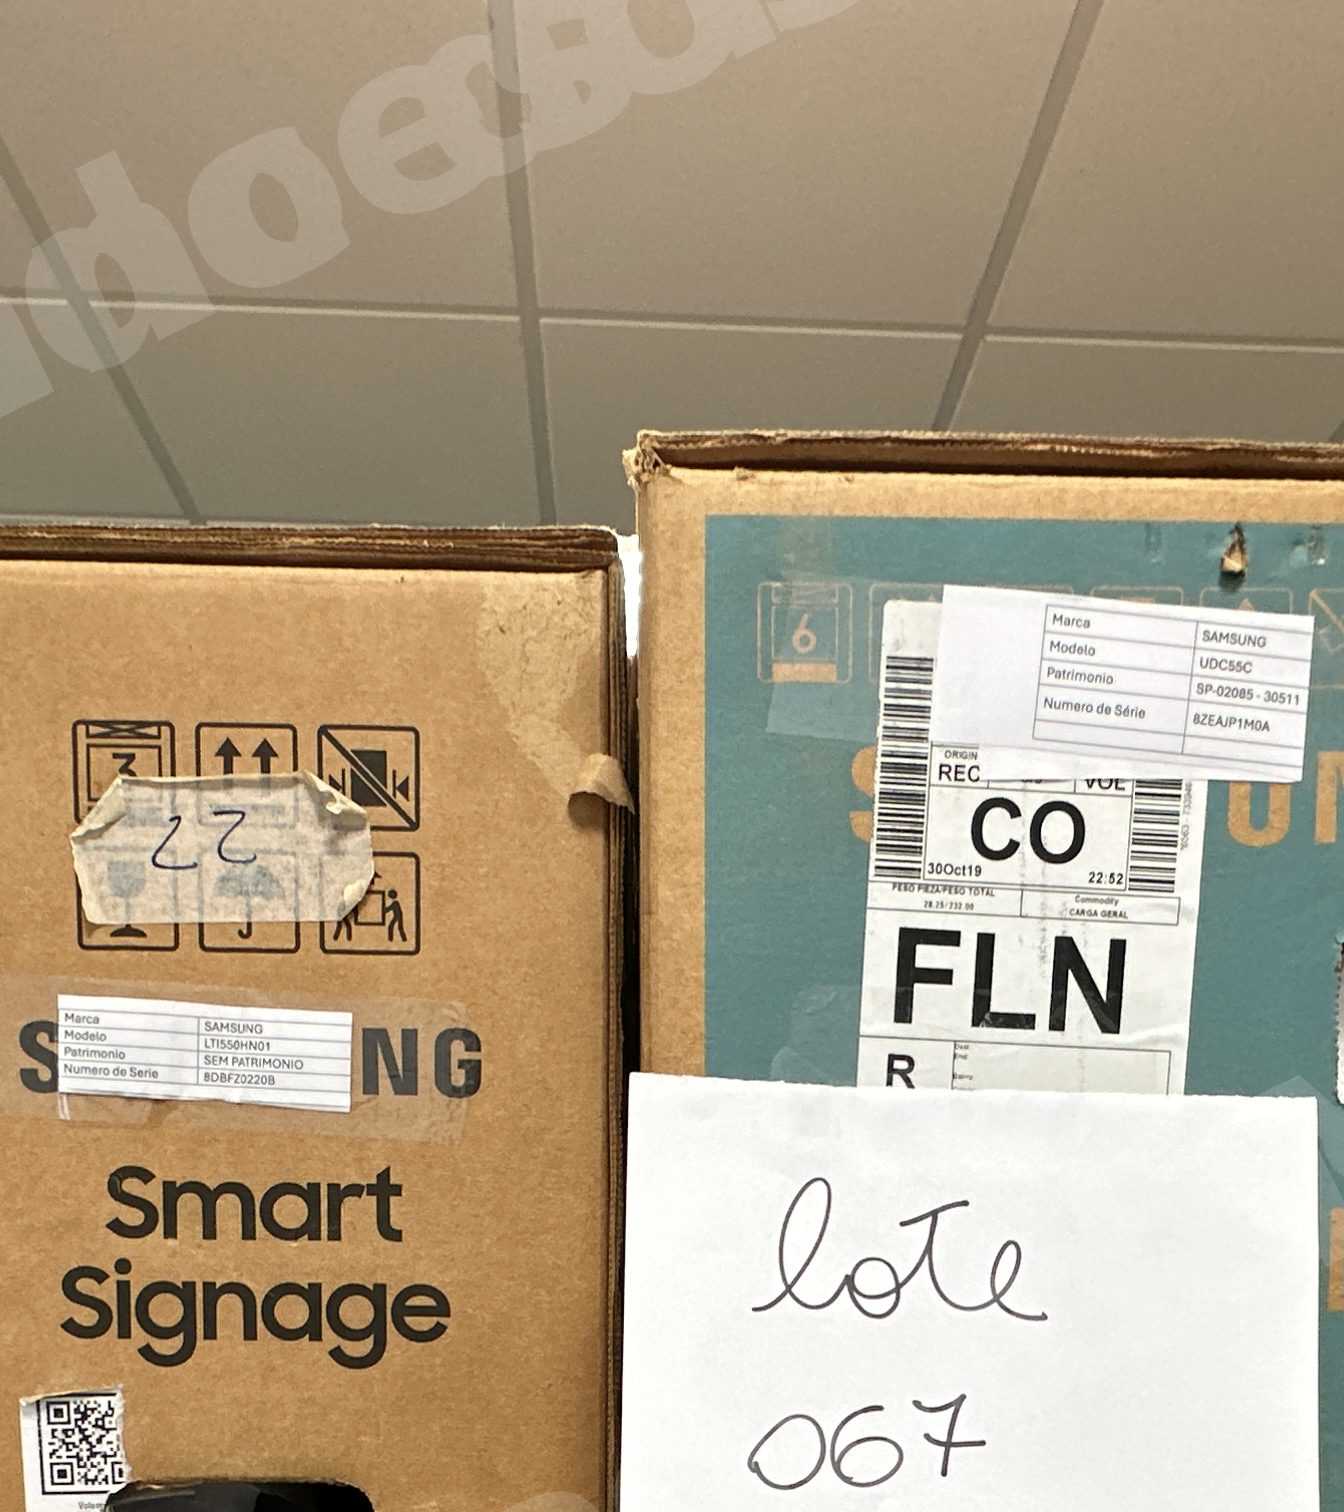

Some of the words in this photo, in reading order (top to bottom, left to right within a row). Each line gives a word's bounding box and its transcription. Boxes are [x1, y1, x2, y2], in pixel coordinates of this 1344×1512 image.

[1052, 614, 1091, 629] Marca
[1202, 631, 1266, 648] SAMSUNG
[1049, 640, 1095, 656] Modelo
[1200, 657, 1253, 673] UDC55C
[1047, 667, 1114, 684] Patrimonio
[1196, 683, 1253, 699] SP-02085
[1264, 691, 1300, 706] 30511
[1043, 699, 1093, 714] Numero
[1096, 703, 1111, 715] de
[1114, 703, 1145, 718] Série
[938, 764, 980, 782] REC
[971, 797, 1085, 864] CO
[928, 863, 982, 877] 30Oct19
[1088, 872, 1123, 885] 22:52
[894, 927, 1126, 1034] FLN
[65, 1013, 99, 1025] Marca
[64, 1030, 107, 1042] Modelo
[204, 1022, 263, 1034] SAMSUNG
[64, 1047, 126, 1060] Patrimonio
[64, 1064, 110, 1076] Numero
[114, 1066, 127, 1076] de
[204, 1056, 228, 1066] SEM
[232, 1058, 304, 1070] PATRIMONIO
[886, 1054, 915, 1089] R
[105, 1166, 404, 1242] Smart
[61, 1258, 451, 1368] Signage
[747, 1395, 986, 1489] 067
